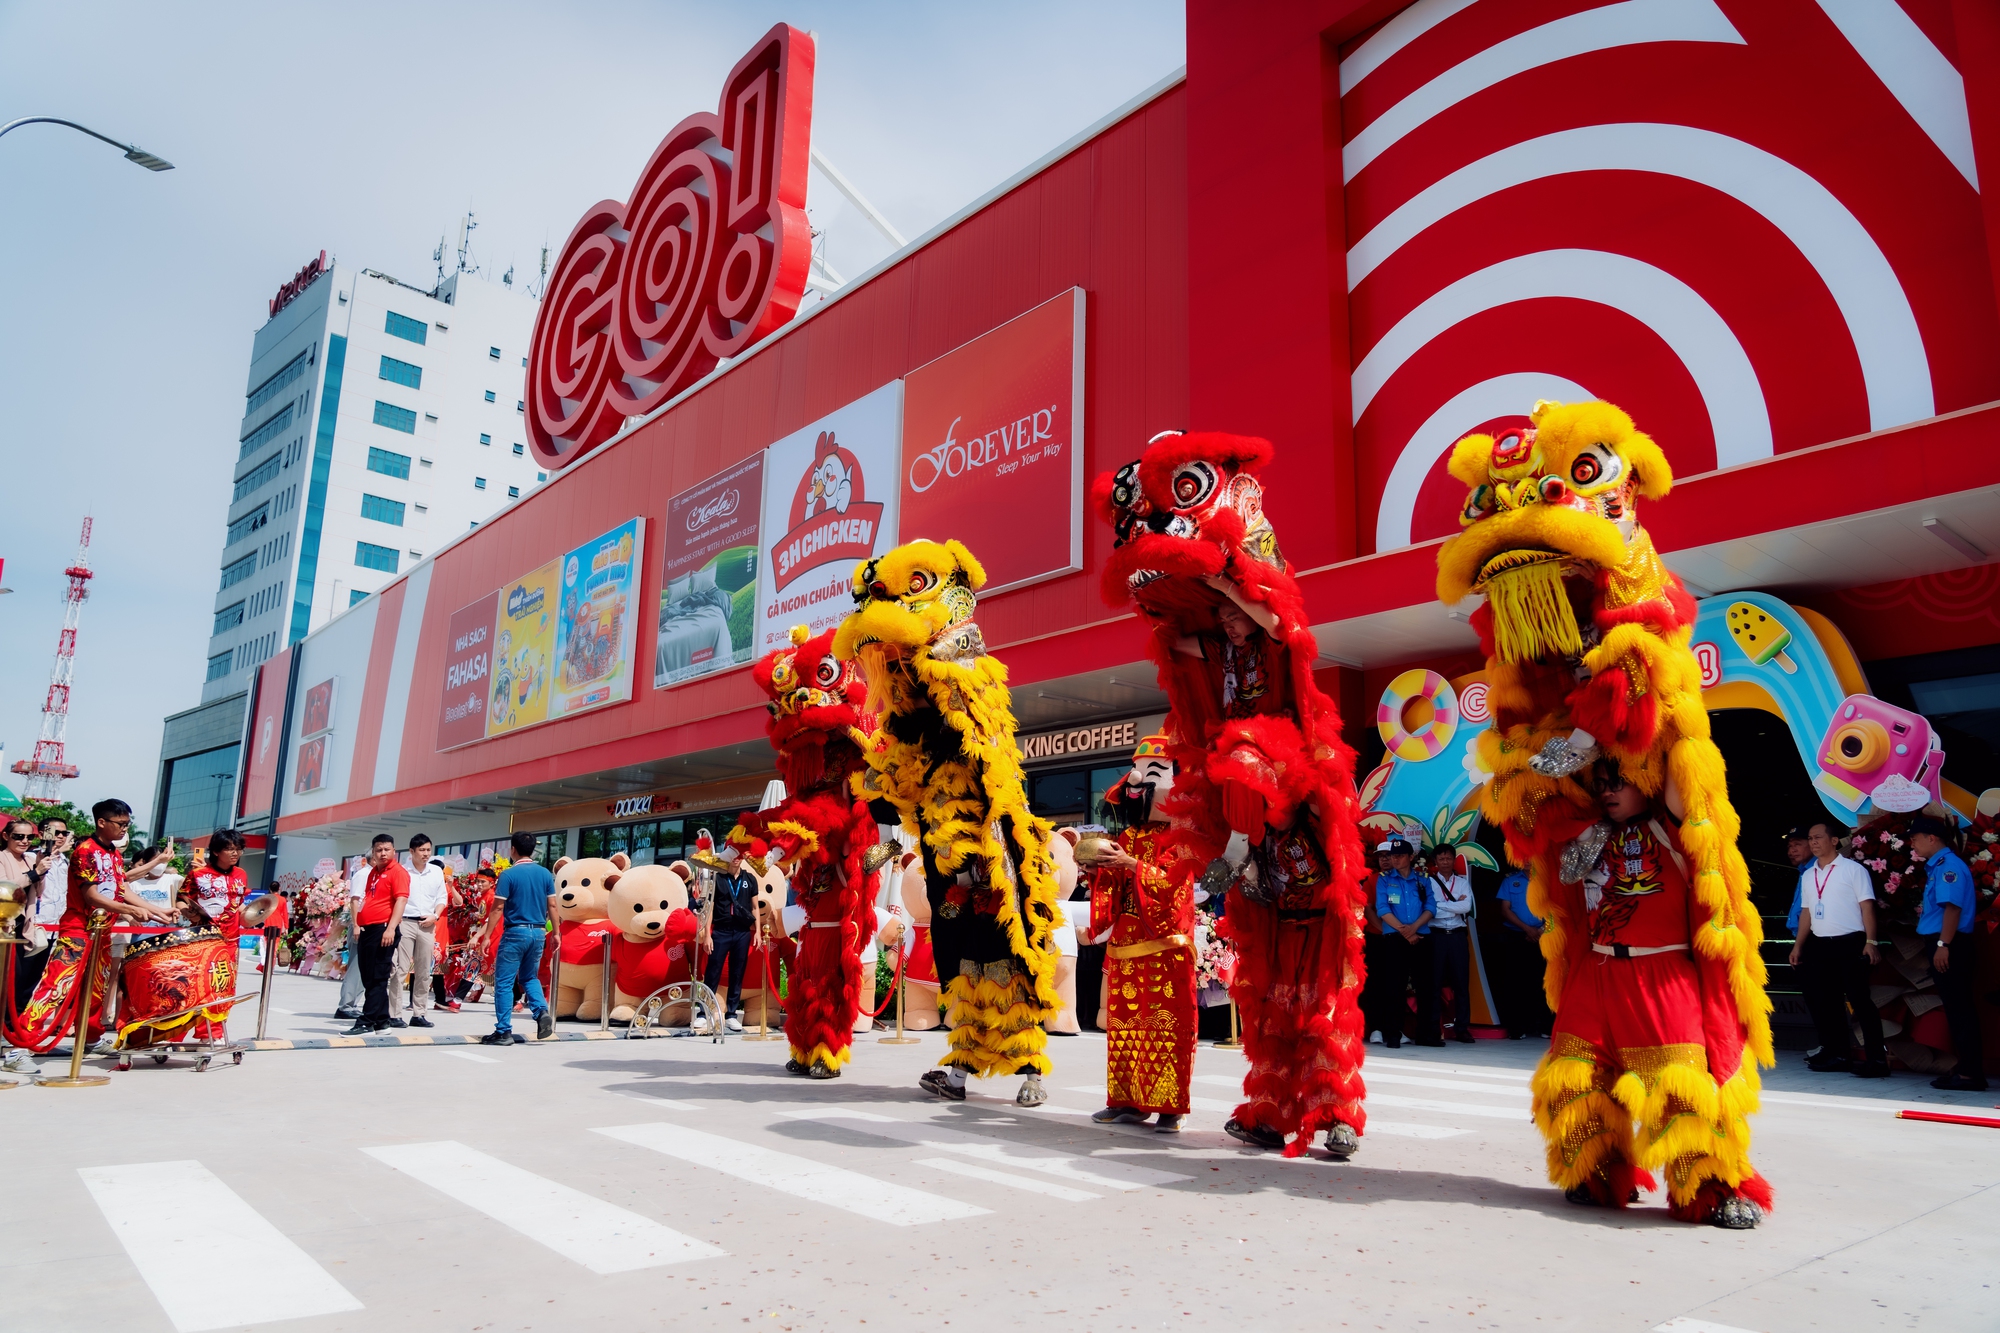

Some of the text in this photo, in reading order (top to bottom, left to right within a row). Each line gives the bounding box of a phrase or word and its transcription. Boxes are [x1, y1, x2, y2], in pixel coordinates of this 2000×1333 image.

[525, 22, 815, 470] GO!
[269, 249, 326, 318] viettel
[996, 443, 1063, 477] Sleep Your Way
[707, 541, 720, 552] WITH
[725, 531, 742, 544] GOOD
[741, 524, 757, 537] SLEEP
[779, 538, 801, 577] 3H
[801, 518, 873, 558] CHICKEN
[609, 563, 627, 581] KIDS
[767, 599, 779, 619] GÀ
[781, 593, 808, 614] NGON
[808, 574, 844, 605] CHUẨN
[455, 633, 469, 653] NHÀ
[469, 625, 487, 647] SÁCH
[775, 630, 789, 642] GIAO
[447, 652, 487, 691] FAHASA
[1024, 722, 1136, 758] KING COFFEE
[614, 795, 652, 818] DOOKKI
[1623, 838, 1643, 876] 楊輝
